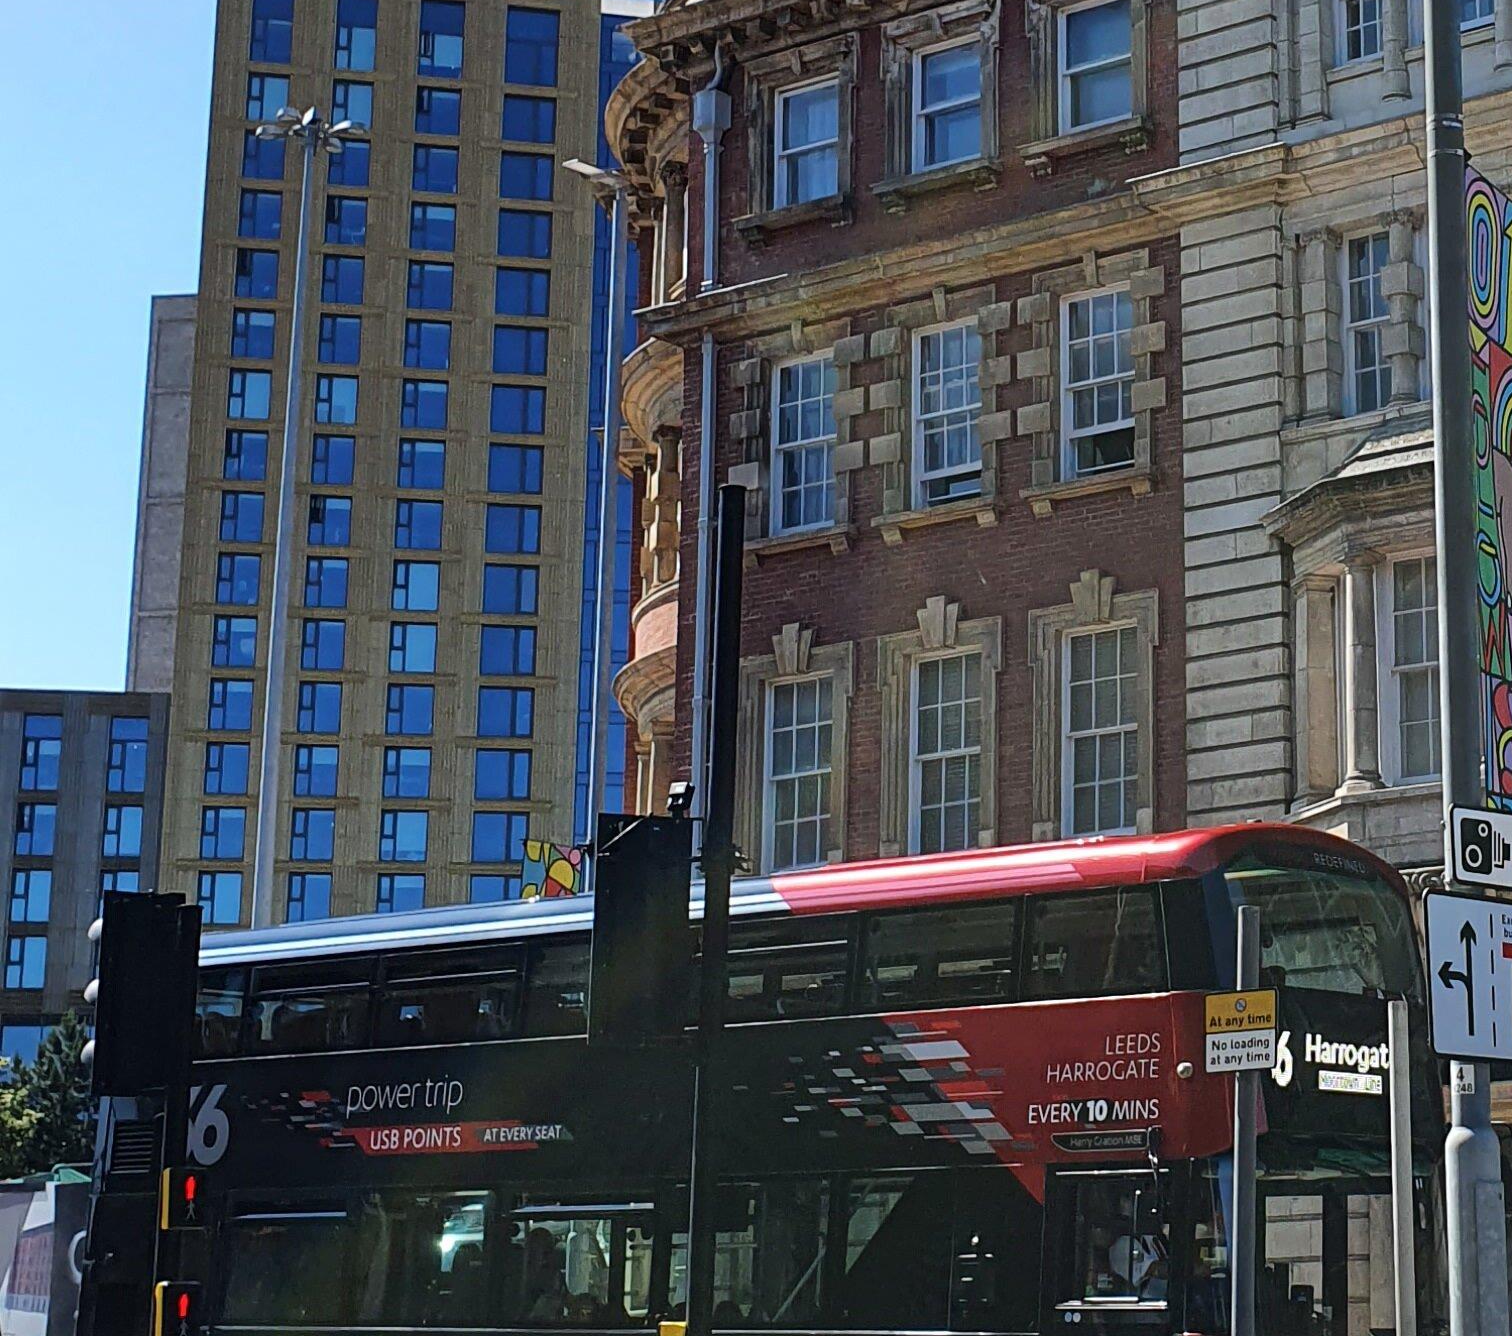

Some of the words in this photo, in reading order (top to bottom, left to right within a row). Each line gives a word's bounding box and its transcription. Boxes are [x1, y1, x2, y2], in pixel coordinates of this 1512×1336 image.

[1209, 1016, 1222, 1028] At
[1225, 1017, 1244, 1028] any
[1247, 1013, 1272, 1024] time
[1105, 1033, 1161, 1055] LEEDS
[1211, 1040, 1227, 1051] No
[1230, 1036, 1270, 1050] loading
[1210, 1055, 1221, 1065] at
[1224, 1054, 1243, 1066] any
[1247, 1051, 1271, 1062] time
[1271, 1030, 1294, 1087] 6
[1304, 1032, 1391, 1073] Harrogat
[1046, 1058, 1160, 1084] HARROGATE
[1456, 1066, 1465, 1082] 4
[346, 1082, 421, 1120] power
[425, 1074, 464, 1114] trip
[1028, 1102, 1083, 1125] EVERY
[1086, 1099, 1108, 1122] 10
[1112, 1098, 1160, 1121] MINS
[370, 1130, 399, 1150] USB
[403, 1126, 462, 1149] POINTS
[483, 1128, 497, 1143] AT
[499, 1126, 535, 1142] EVERY
[535, 1124, 563, 1140] SEAT
